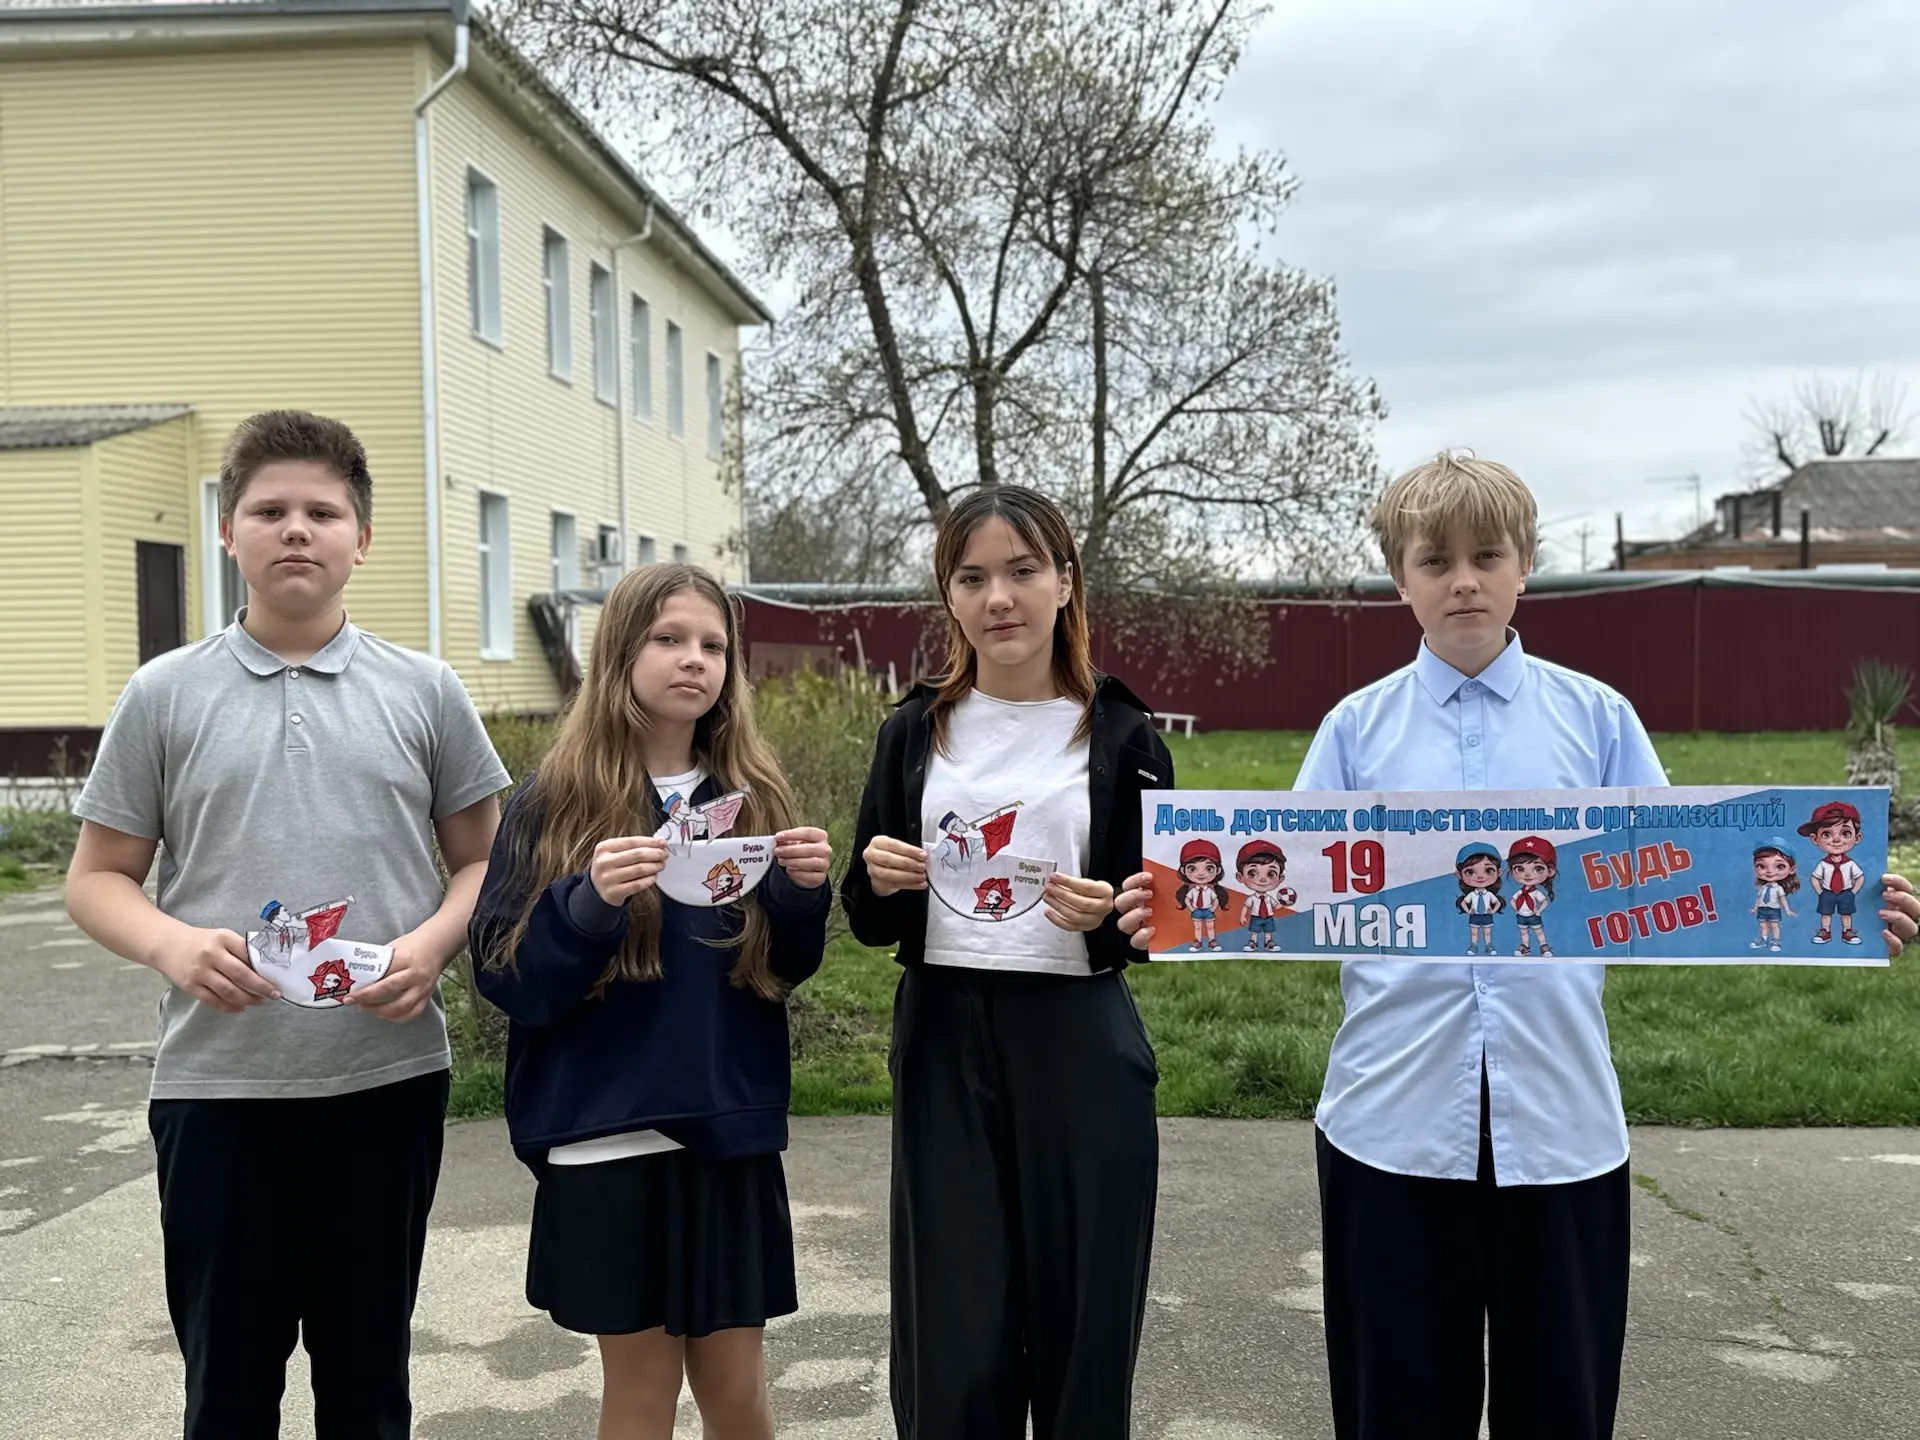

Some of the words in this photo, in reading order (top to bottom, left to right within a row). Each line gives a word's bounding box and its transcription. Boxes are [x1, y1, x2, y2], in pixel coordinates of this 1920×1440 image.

[1154, 804, 1224, 835] День
[1230, 808, 1347, 836] детских
[1353, 804, 1578, 836] общественных
[1585, 797, 1785, 833] организаций
[742, 843, 765, 853] Будь
[1322, 840, 1385, 895] 19
[1580, 840, 1692, 893] Будь
[1586, 884, 1719, 950] готов!
